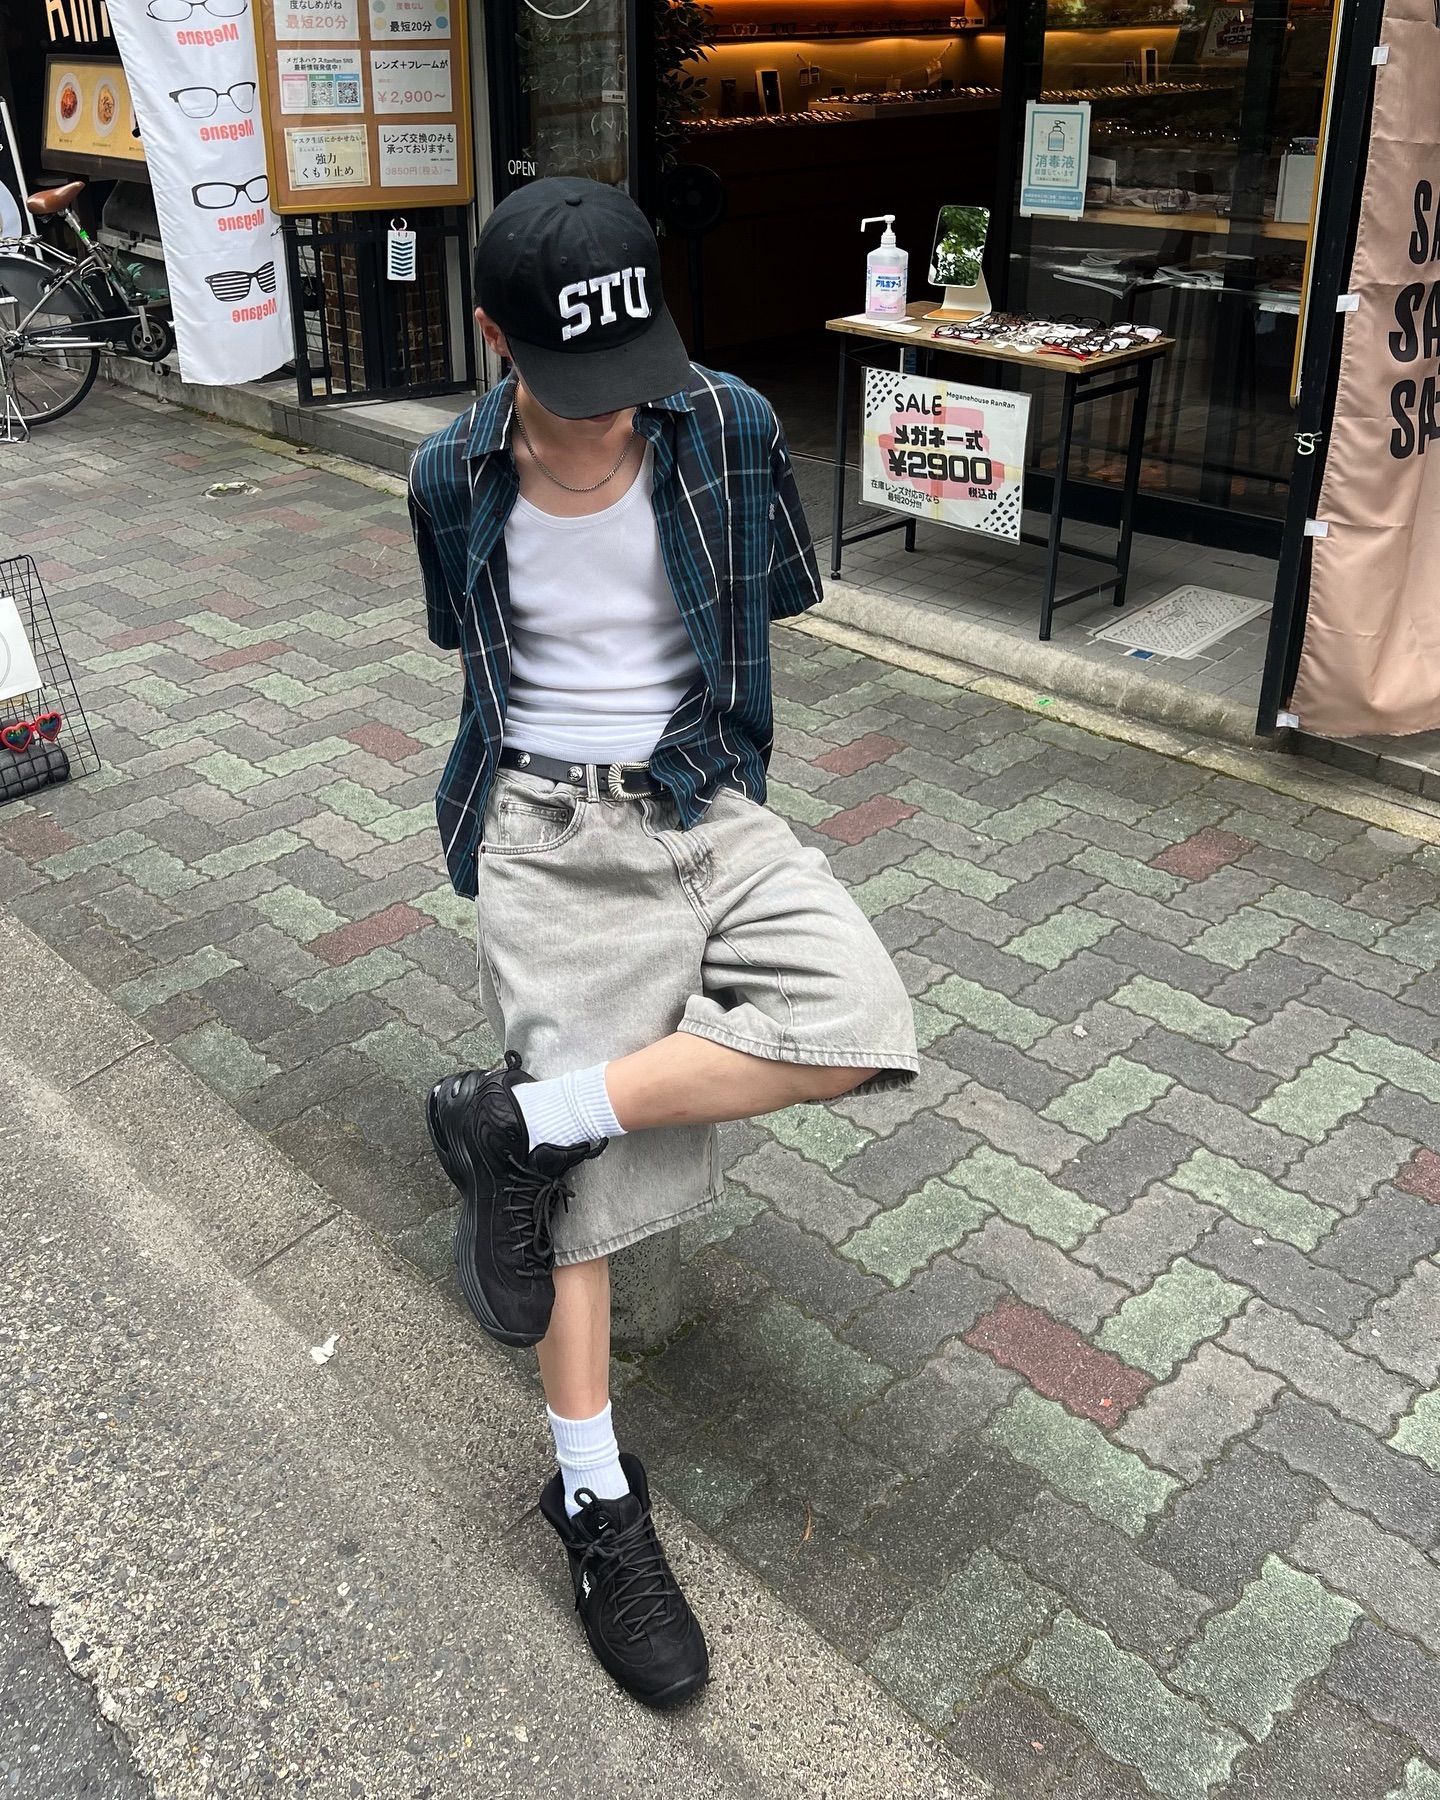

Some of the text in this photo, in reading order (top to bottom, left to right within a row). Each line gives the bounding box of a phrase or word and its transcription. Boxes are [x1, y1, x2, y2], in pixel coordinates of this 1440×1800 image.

[287, 14, 349, 29] 最短20分
[389, 20, 432, 32] 最短20分
[292, 135, 362, 144] マスク生活にかかせない
[383, 133, 454, 143] レンズ交換のみも
[386, 144, 450, 154] 承っております。
[315, 152, 337, 165] 強力
[1035, 154, 1075, 169] 消毒液
[302, 165, 354, 178] くもり止め
[508, 159, 536, 176] OPEN
[559, 267, 649, 341] STU
[894, 393, 943, 416] SALE
[946, 391, 1016, 410] Meganehouse RanRan
[894, 425, 984, 451] メガネ一式
[888, 449, 993, 485] ¥2900
[870, 479, 940, 505] 在庫レンズ対応可なら
[968, 487, 997, 501] 税込み
